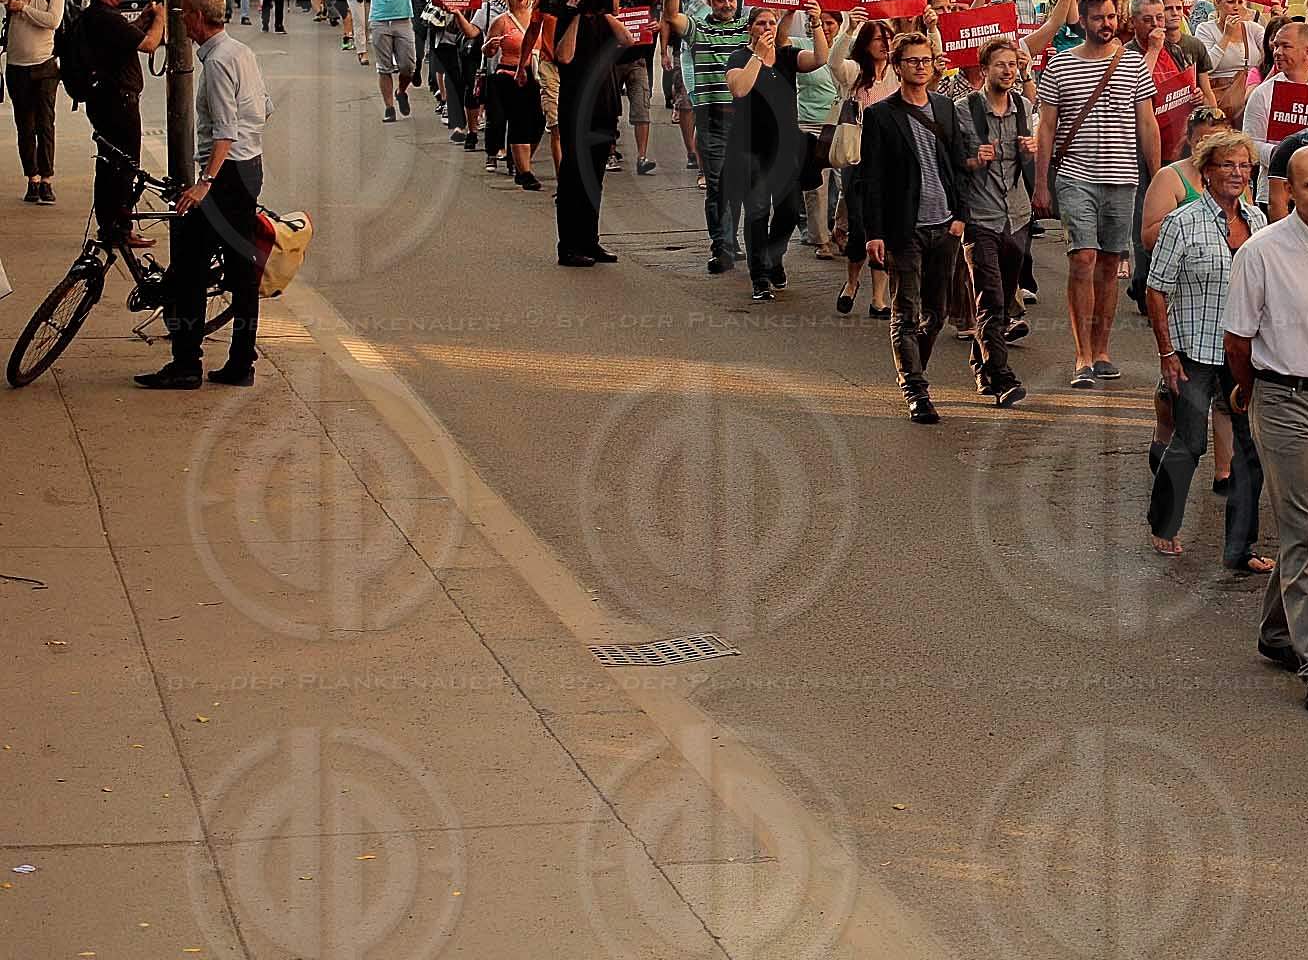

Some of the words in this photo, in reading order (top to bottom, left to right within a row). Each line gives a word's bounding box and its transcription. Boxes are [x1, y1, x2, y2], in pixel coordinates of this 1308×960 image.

[960, 28, 970, 39] ES
[946, 41, 966, 52] FRAU
[1293, 103, 1303, 114] ES
[1273, 111, 1298, 124] FRAU
